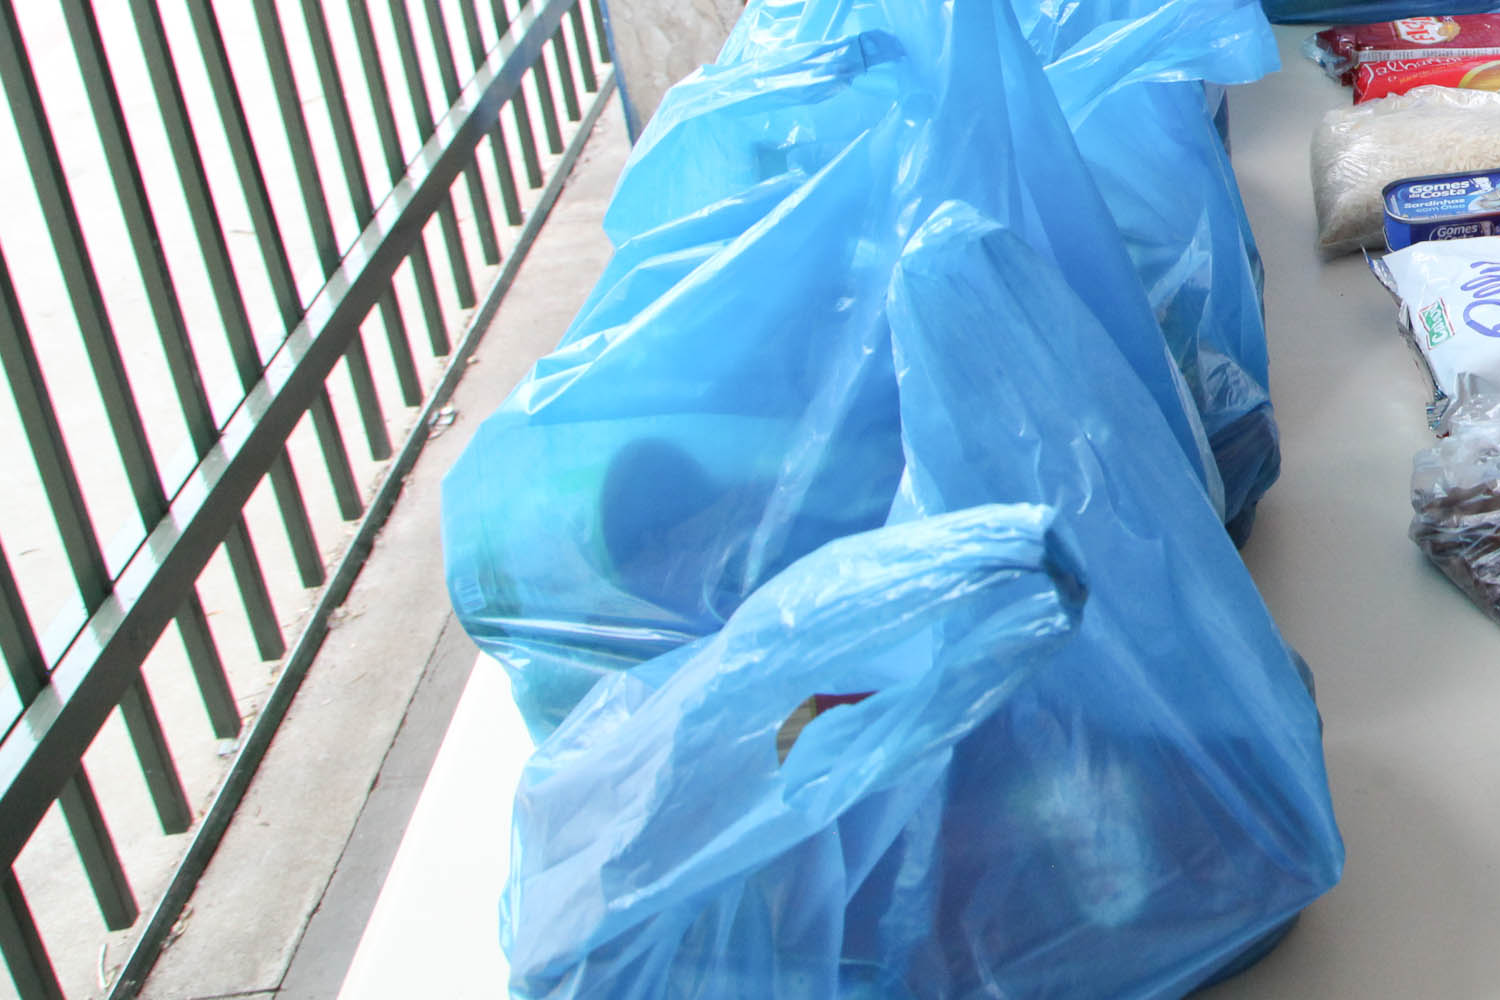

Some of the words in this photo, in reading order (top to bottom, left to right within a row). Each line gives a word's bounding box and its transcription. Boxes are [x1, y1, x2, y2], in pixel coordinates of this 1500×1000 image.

[1409, 179, 1470, 195] Gomes
[1420, 187, 1466, 200] Costa
[1404, 198, 1465, 210] Sardinhas
[1437, 223, 1478, 238] Gomes
